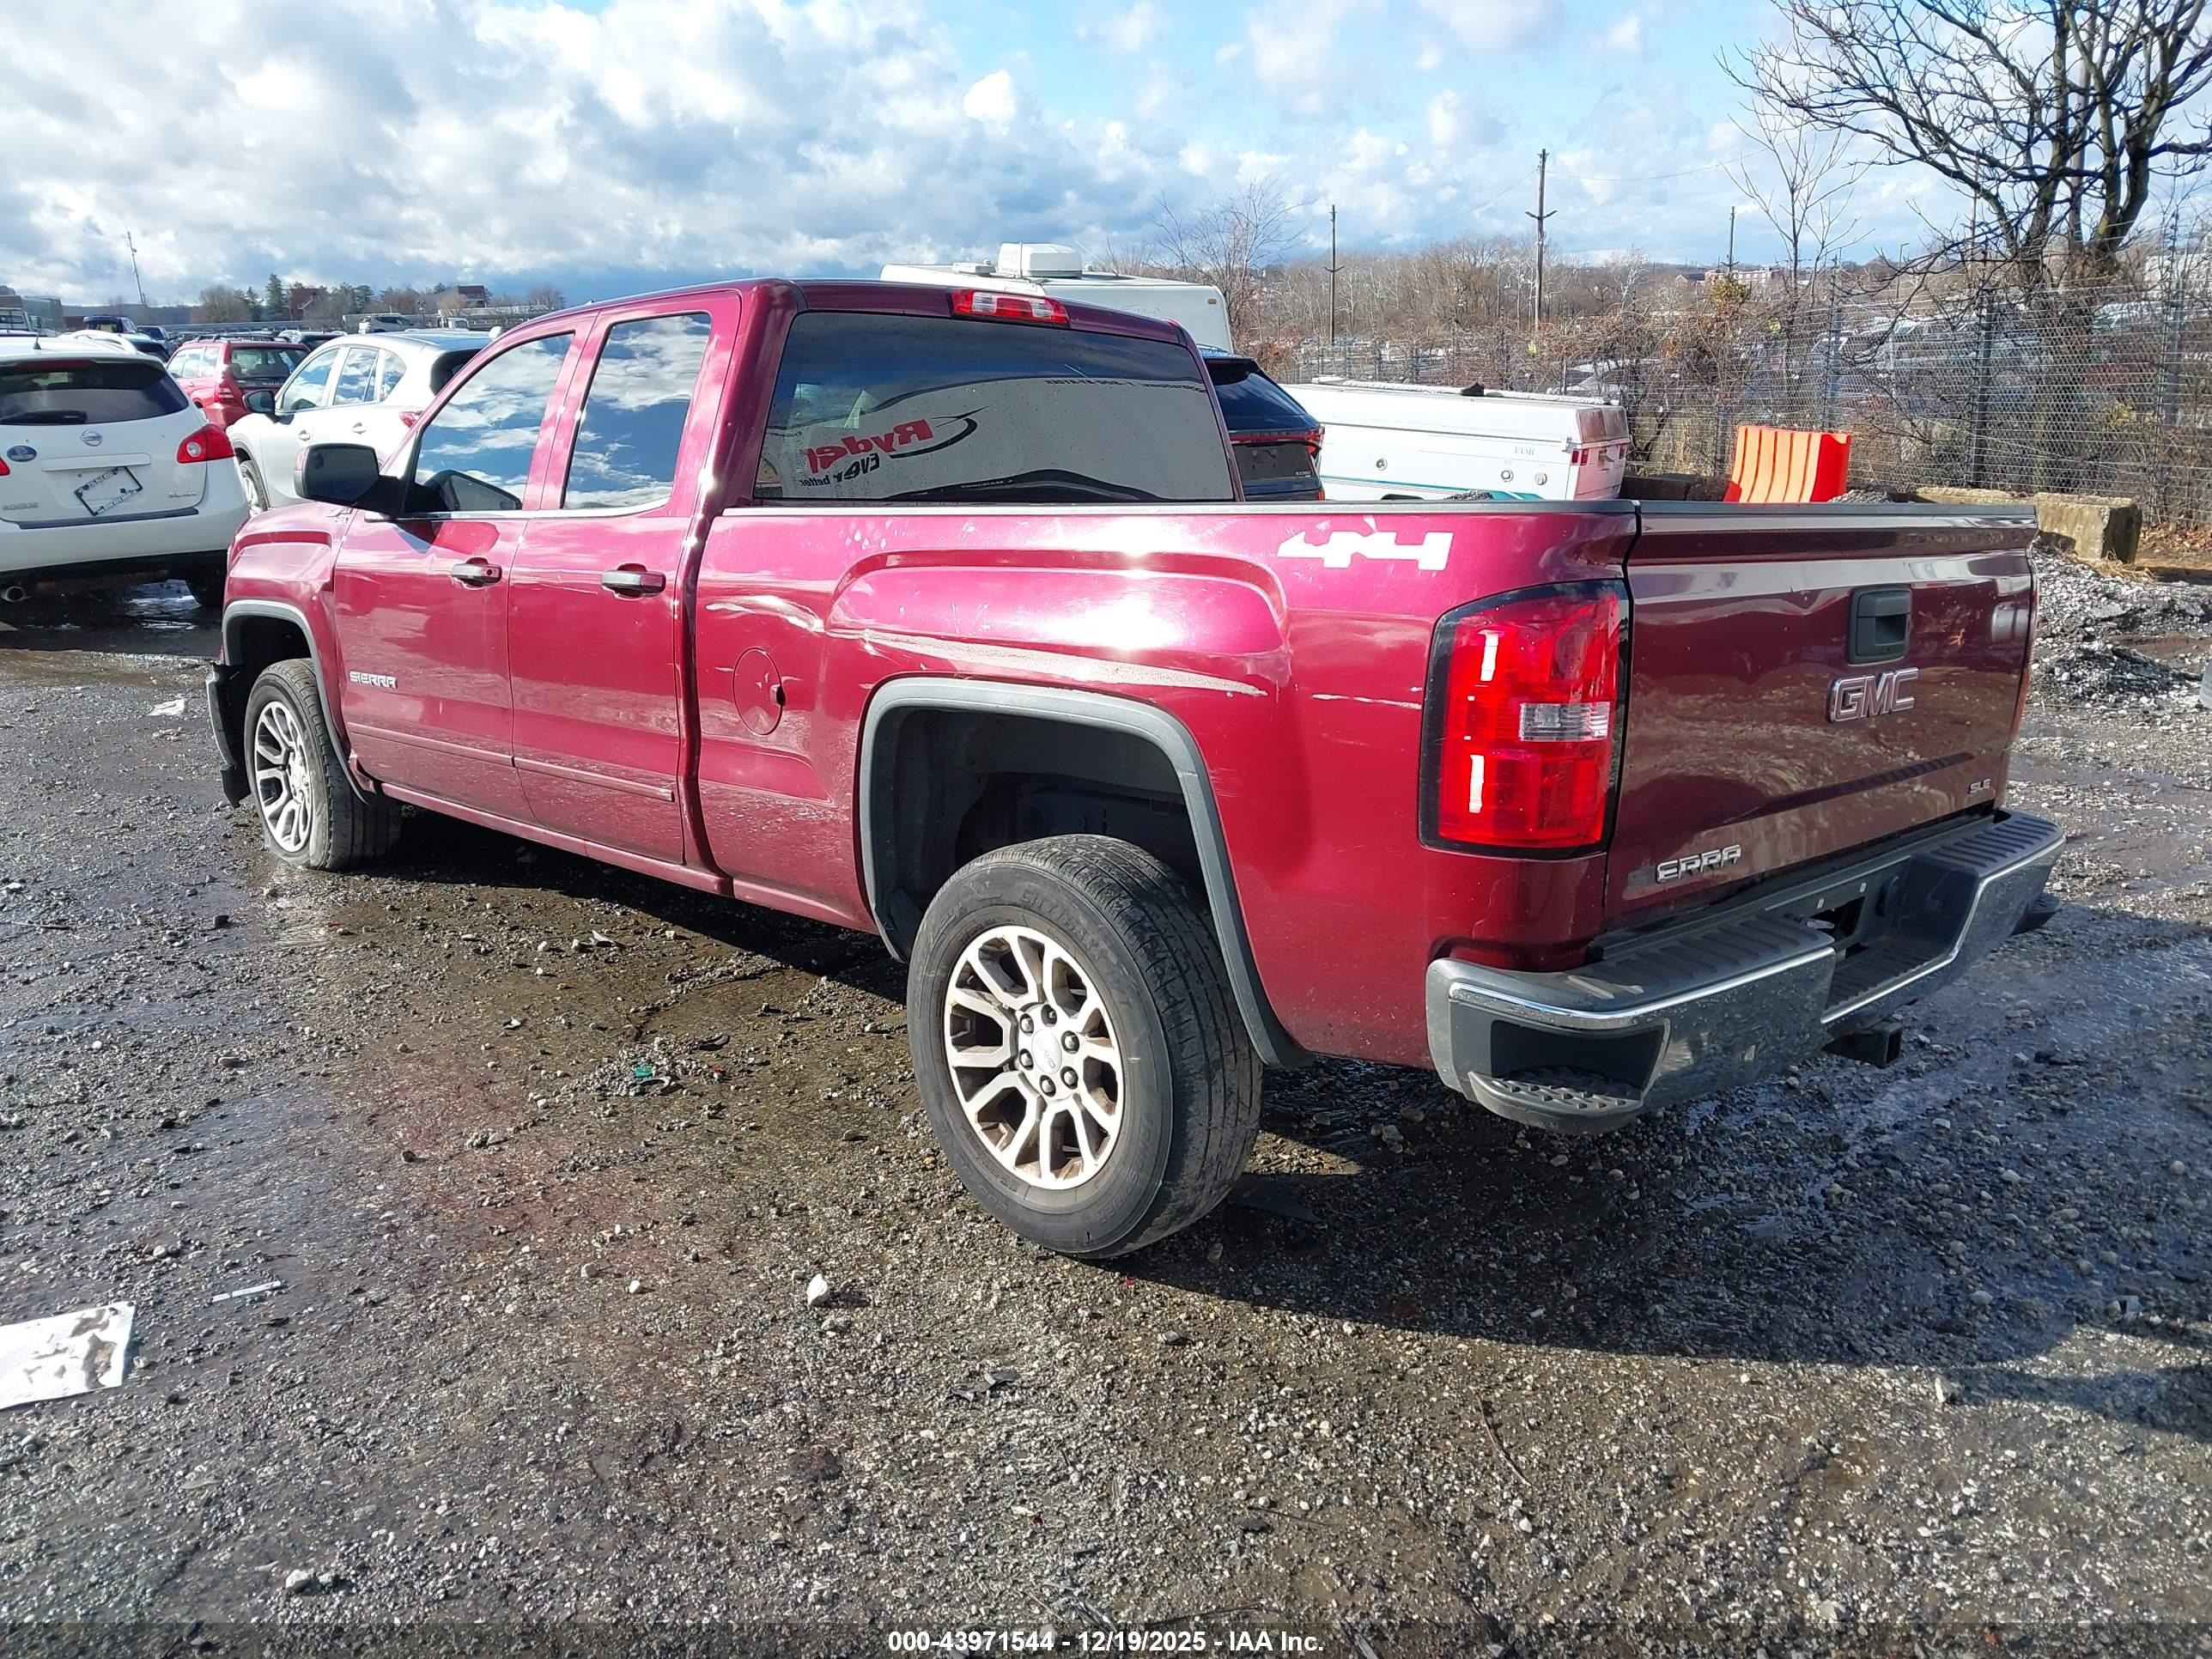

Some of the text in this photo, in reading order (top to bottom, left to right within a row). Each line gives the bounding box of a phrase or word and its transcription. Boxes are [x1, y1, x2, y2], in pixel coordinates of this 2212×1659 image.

[349, 671, 397, 689] SIERRA
[1828, 666, 1920, 723] GMC
[1969, 778, 1991, 794] SLE
